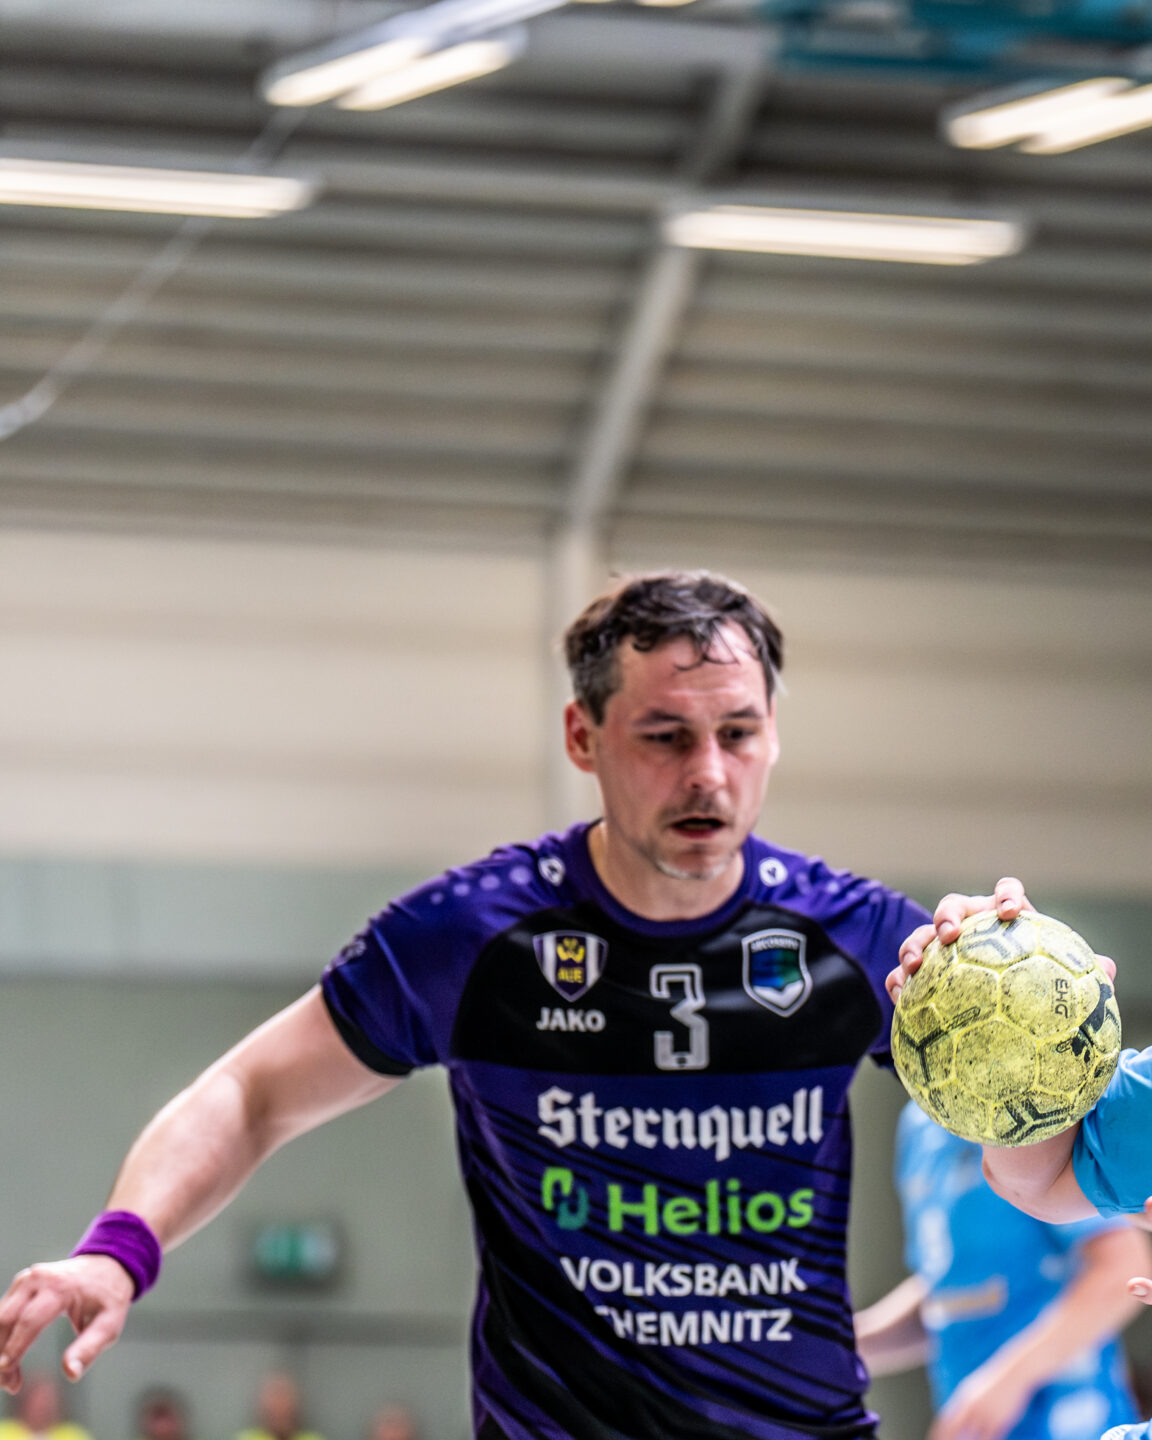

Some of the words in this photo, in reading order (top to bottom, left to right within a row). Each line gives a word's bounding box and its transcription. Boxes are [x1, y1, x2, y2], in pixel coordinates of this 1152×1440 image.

[535, 1006, 606, 1032] JAKO
[649, 963, 710, 1071] 3
[538, 1085, 823, 1162] Sternquell
[607, 1178, 815, 1236] Helios
[560, 1256, 807, 1297] VOLKSBANK
[594, 1305, 793, 1347] HEMNITZ
